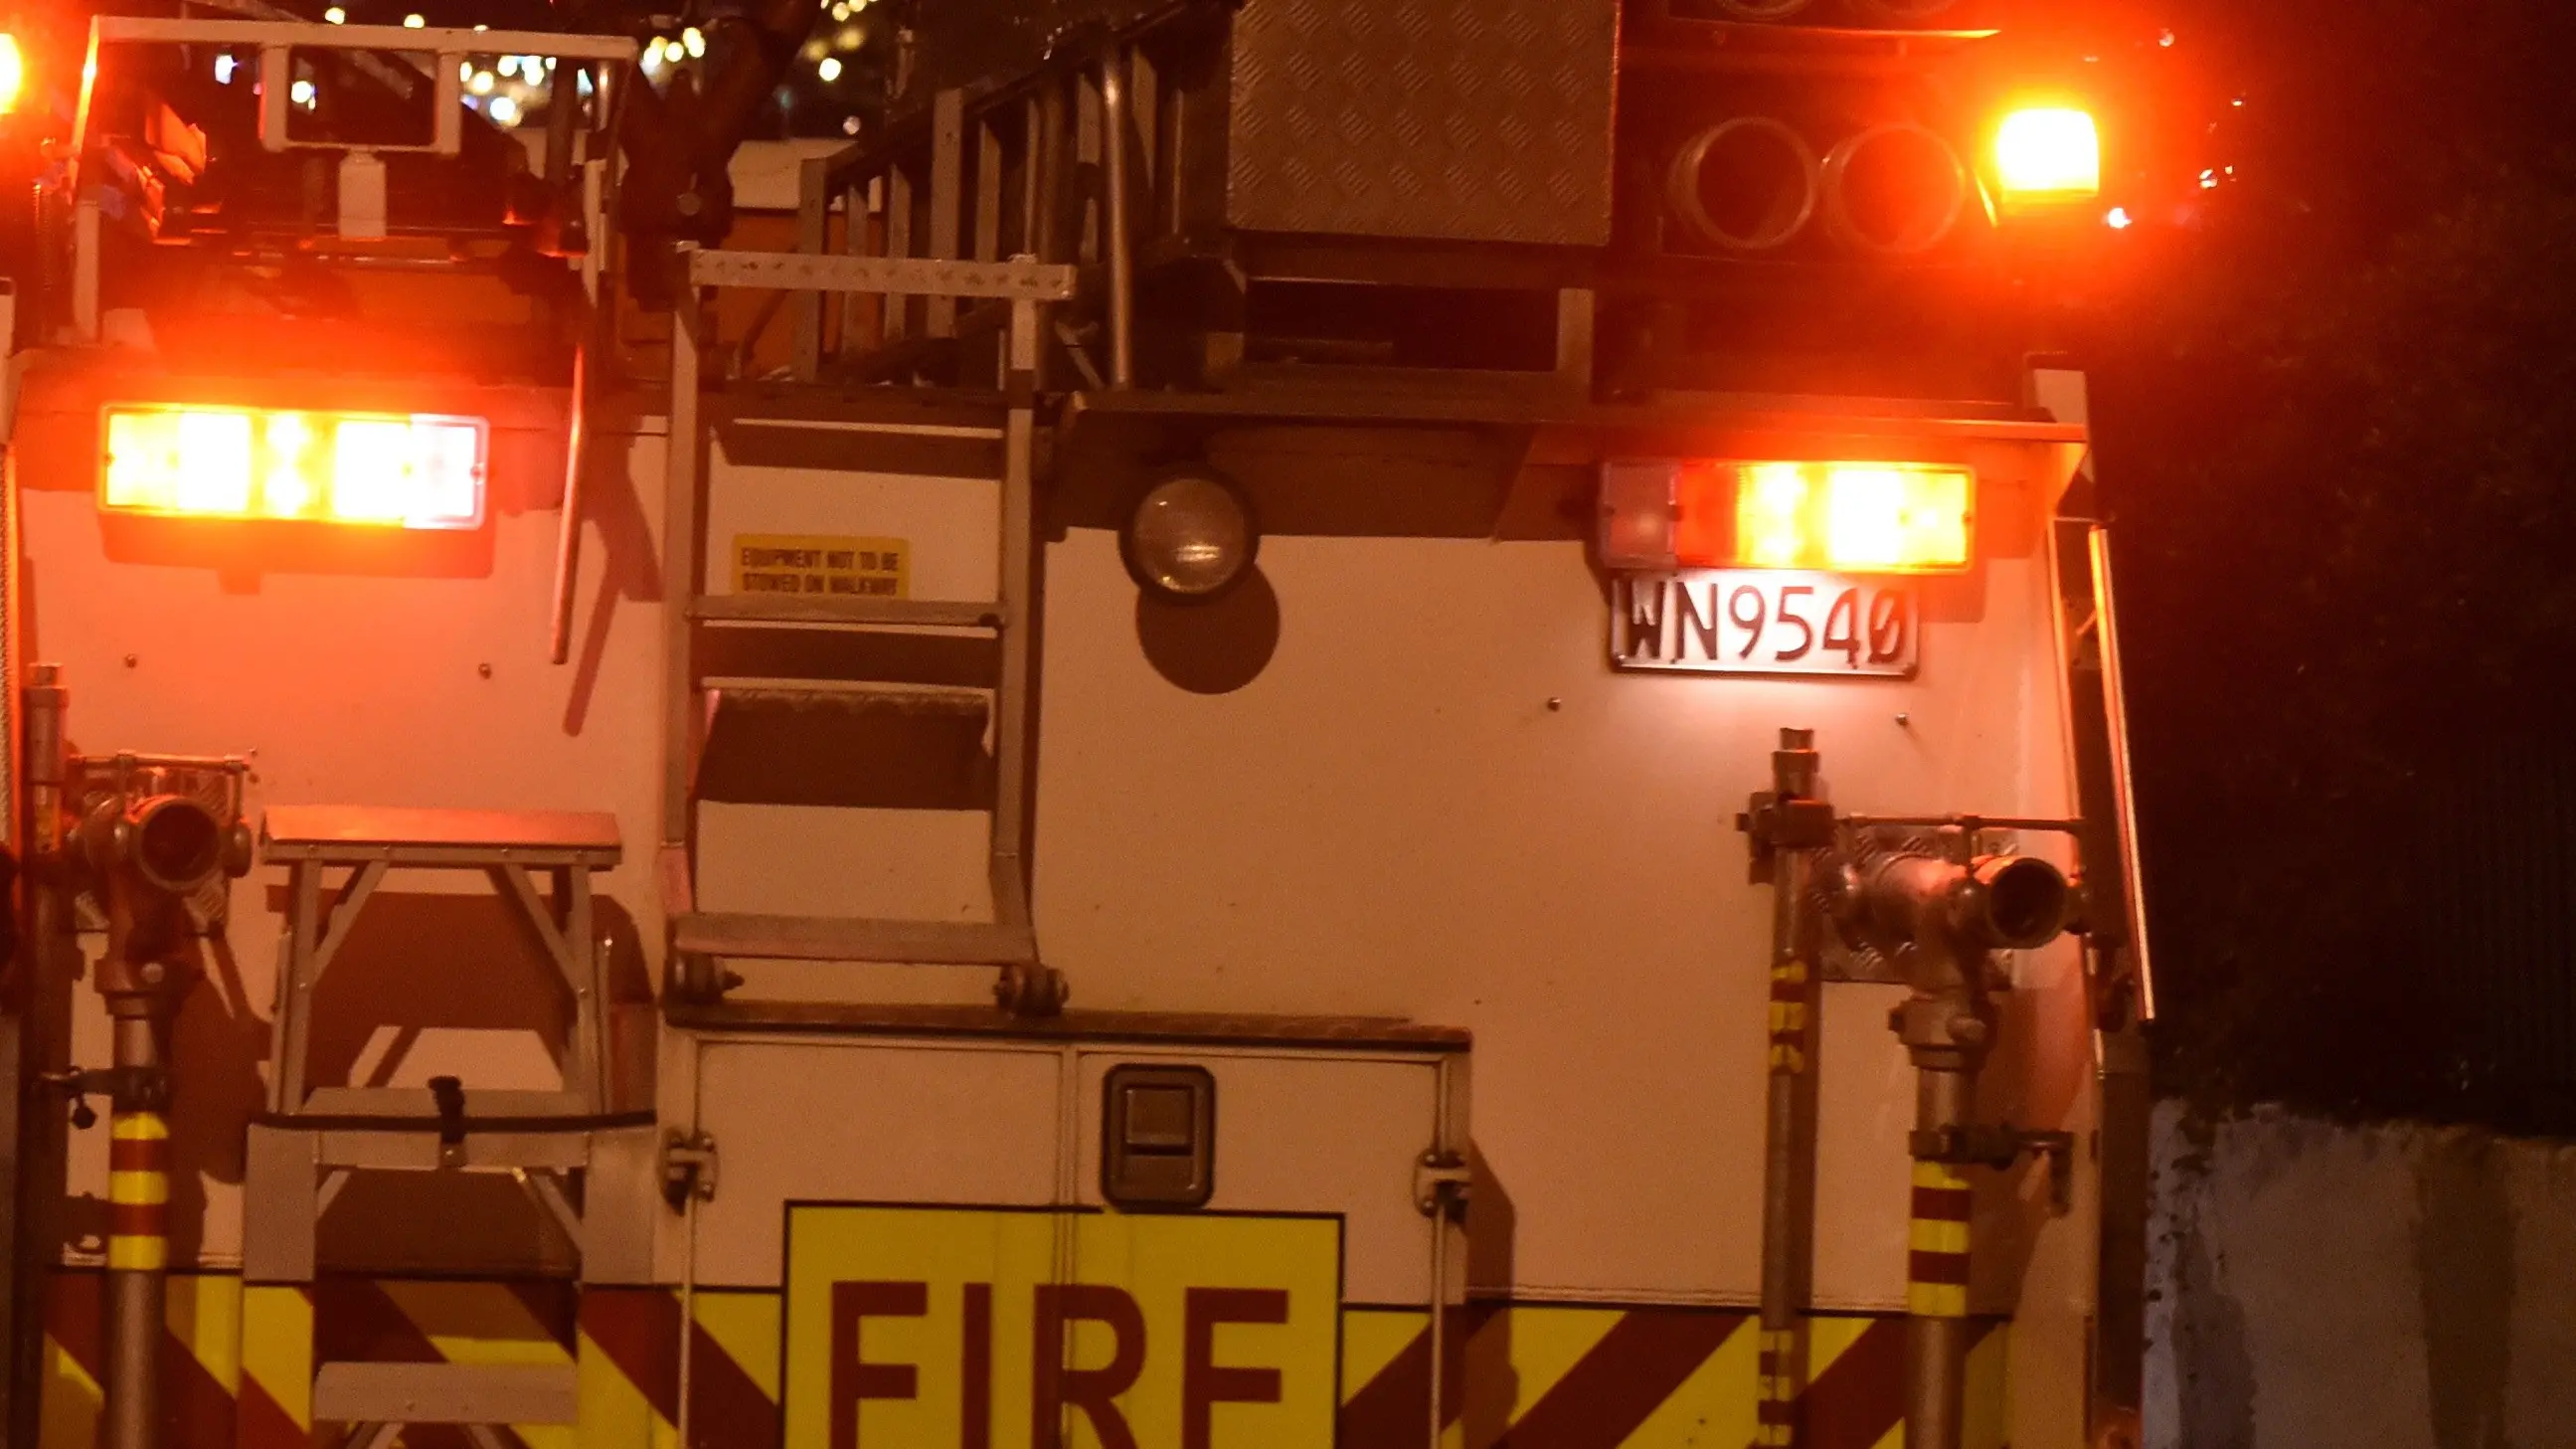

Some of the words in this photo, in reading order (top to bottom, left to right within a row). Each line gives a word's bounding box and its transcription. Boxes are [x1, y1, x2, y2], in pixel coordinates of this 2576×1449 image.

[741, 546, 821, 568] EQUIPMENT
[827, 550, 854, 569] NOT
[860, 551, 878, 570] TO
[882, 552, 899, 571] BE
[742, 573, 800, 593] STOWED
[805, 574, 825, 593] ON
[1620, 580, 1907, 668] WN9540
[829, 1280, 1289, 1449] FIRE
